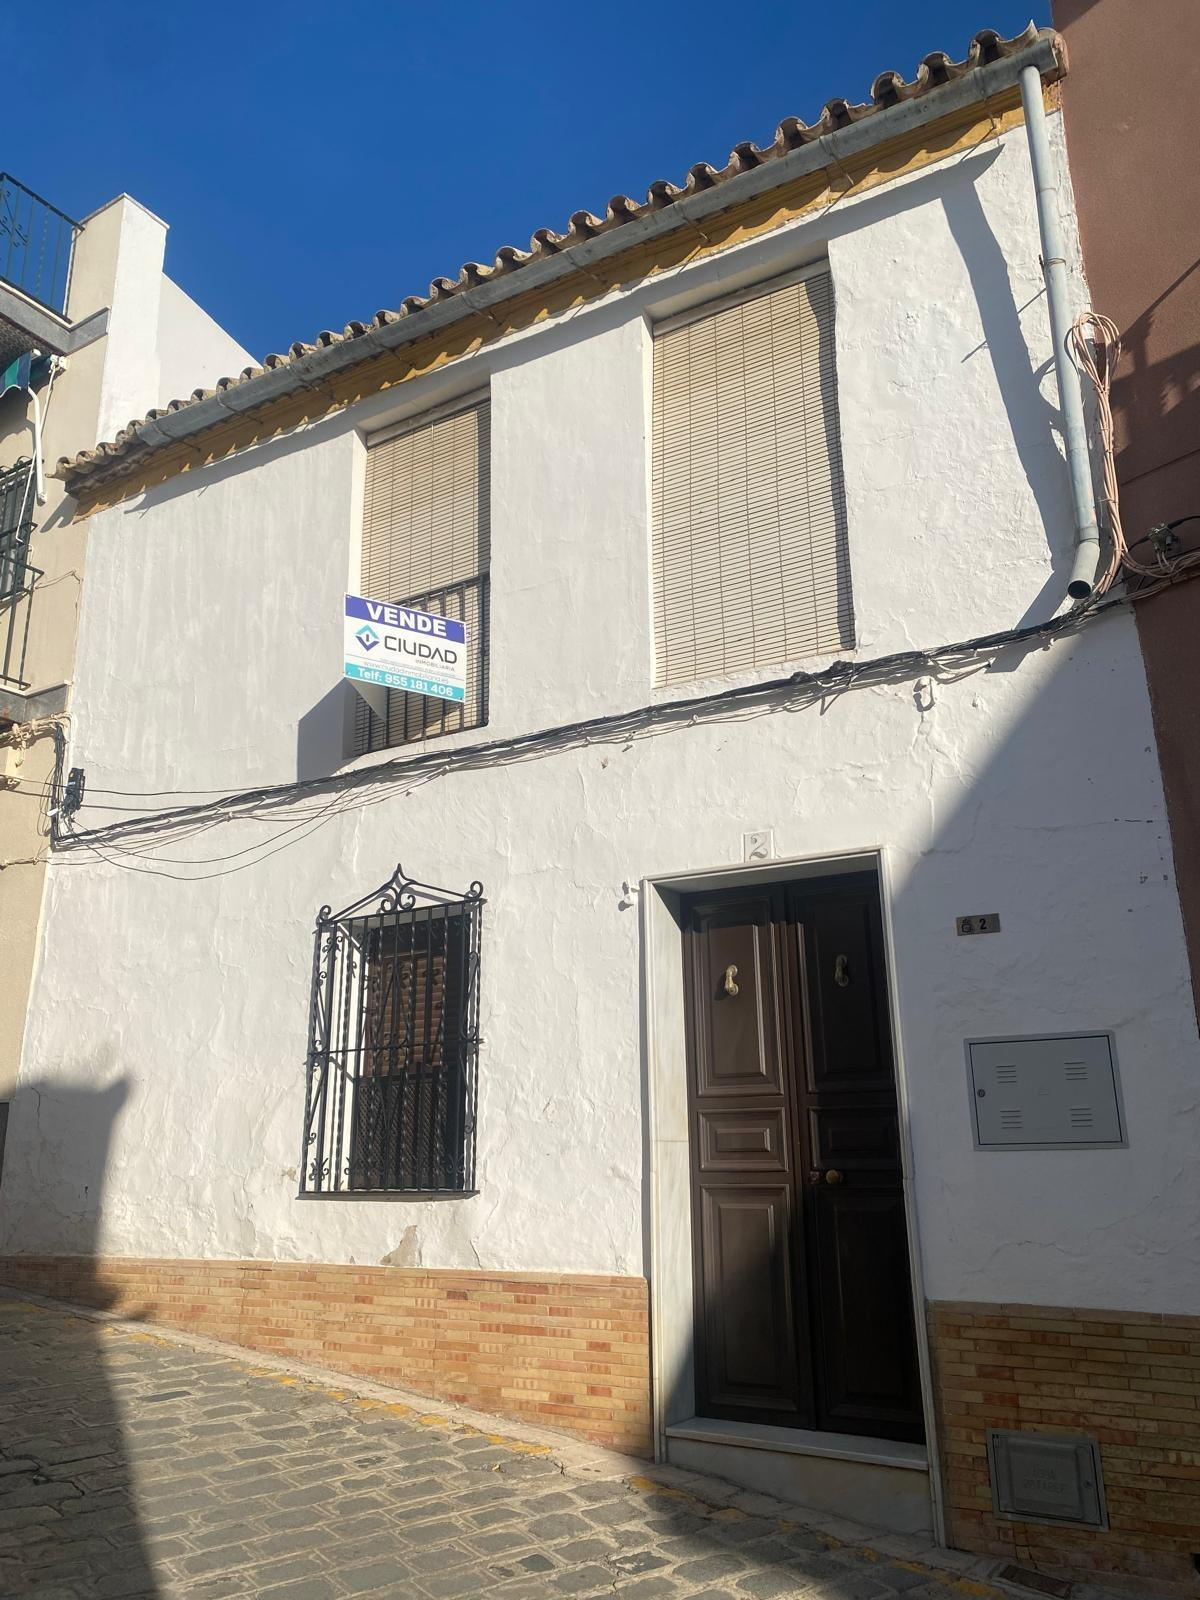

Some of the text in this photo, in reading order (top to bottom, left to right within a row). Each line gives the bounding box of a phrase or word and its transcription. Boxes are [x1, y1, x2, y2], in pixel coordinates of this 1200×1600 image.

[365, 602, 447, 637] VENDE
[384, 635, 458, 664] CIUDAD
[357, 667, 382, 682] Telf:
[384, 673, 408, 687] 955
[410, 679, 428, 690] 181
[430, 684, 454, 697] 406
[749, 832, 768, 860] 2
[979, 918, 987, 930] 2
